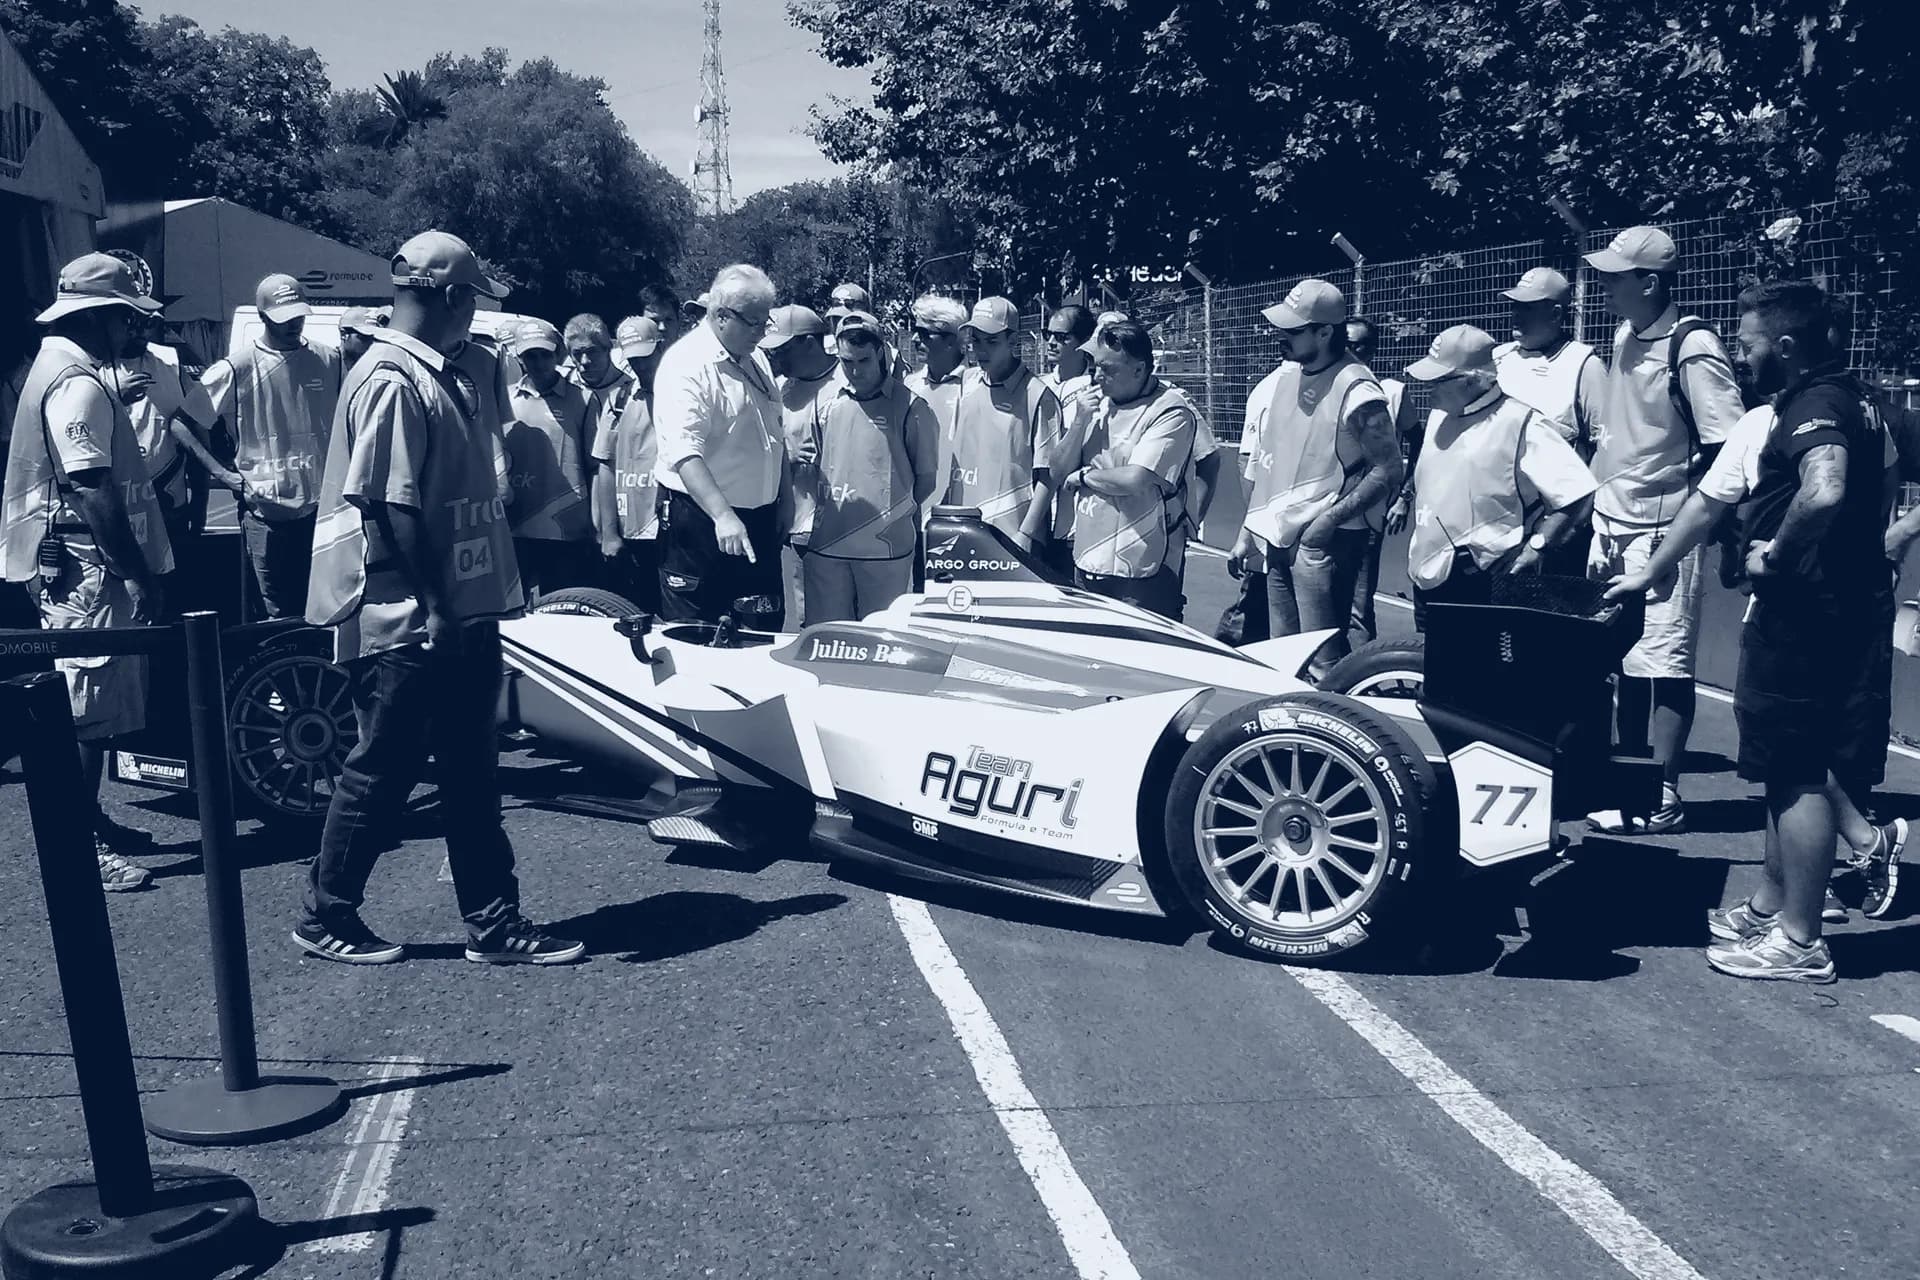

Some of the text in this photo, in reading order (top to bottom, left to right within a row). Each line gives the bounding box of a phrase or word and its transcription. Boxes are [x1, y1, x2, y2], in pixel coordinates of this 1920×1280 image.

[68, 423, 89, 437] FIA
[459, 545, 490, 572] 04
[926, 559, 1020, 570] ARGO GROUP
[809, 639, 868, 661] Julius
[1241, 720, 1259, 735] 77
[1297, 712, 1378, 755] MICHELIN
[139, 762, 186, 778] MICHELIN
[966, 744, 1034, 779] Team
[920, 751, 1085, 829] Aguri
[912, 822, 938, 837] OMP
[981, 815, 1026, 831] Formula
[1043, 827, 1074, 841] Team
[1249, 935, 1330, 955] MICHELIN
